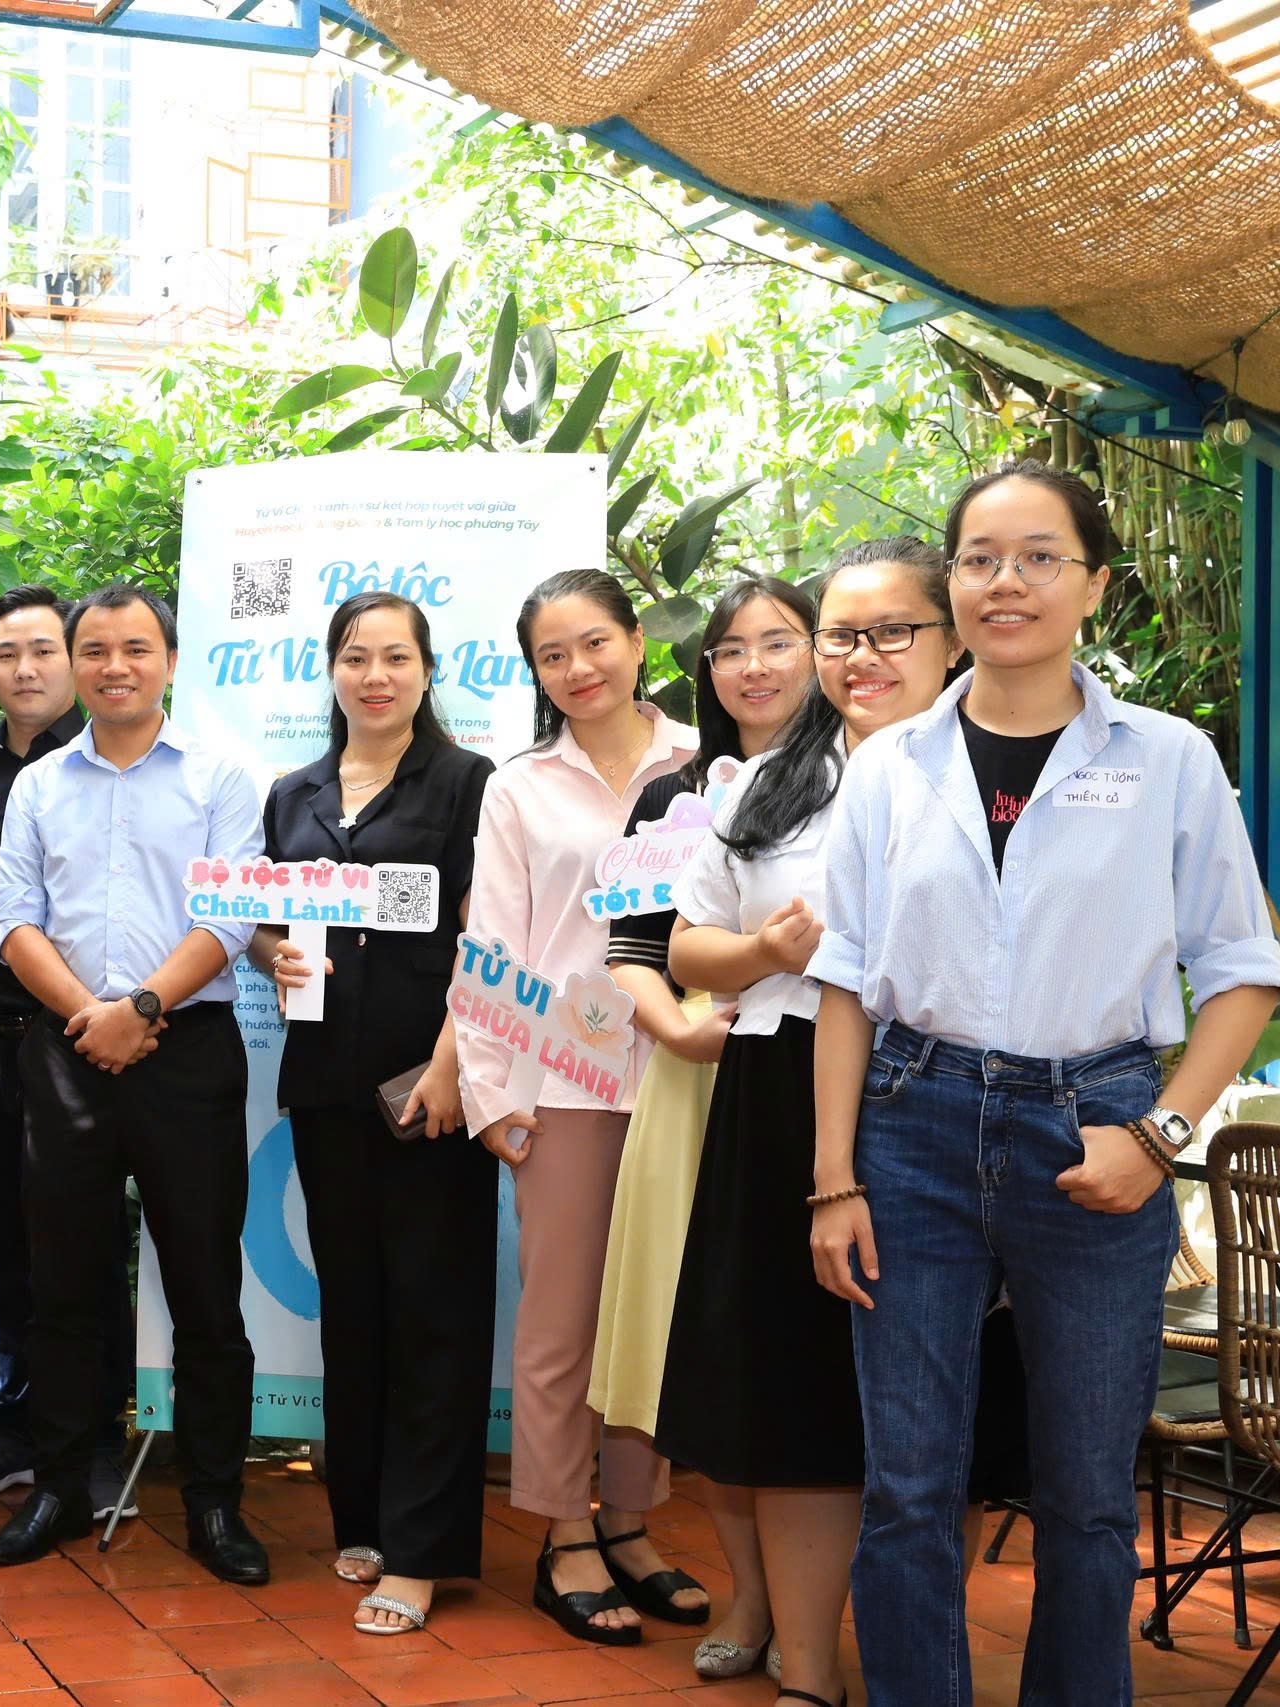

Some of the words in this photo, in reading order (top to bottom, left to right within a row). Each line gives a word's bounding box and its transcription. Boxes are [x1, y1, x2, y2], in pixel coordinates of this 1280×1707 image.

[270, 637, 321, 682] Vi
[452, 640, 534, 701] Làn
[454, 718, 491, 730] trong
[191, 858, 230, 889] BỘ
[239, 861, 290, 890] TỘC
[300, 862, 334, 888] TỬ
[341, 867, 369, 889] VI
[189, 893, 270, 919] Chữa
[282, 897, 362, 923] Lành
[589, 879, 641, 915] TỐT
[245, 982, 268, 994] phá
[462, 938, 510, 987] TỬ
[515, 969, 552, 1017] VI
[237, 1001, 267, 1013] công
[450, 984, 531, 1054] CHỮA
[538, 1036, 621, 1106] LÀNH
[292, 1395, 306, 1407] Vi
